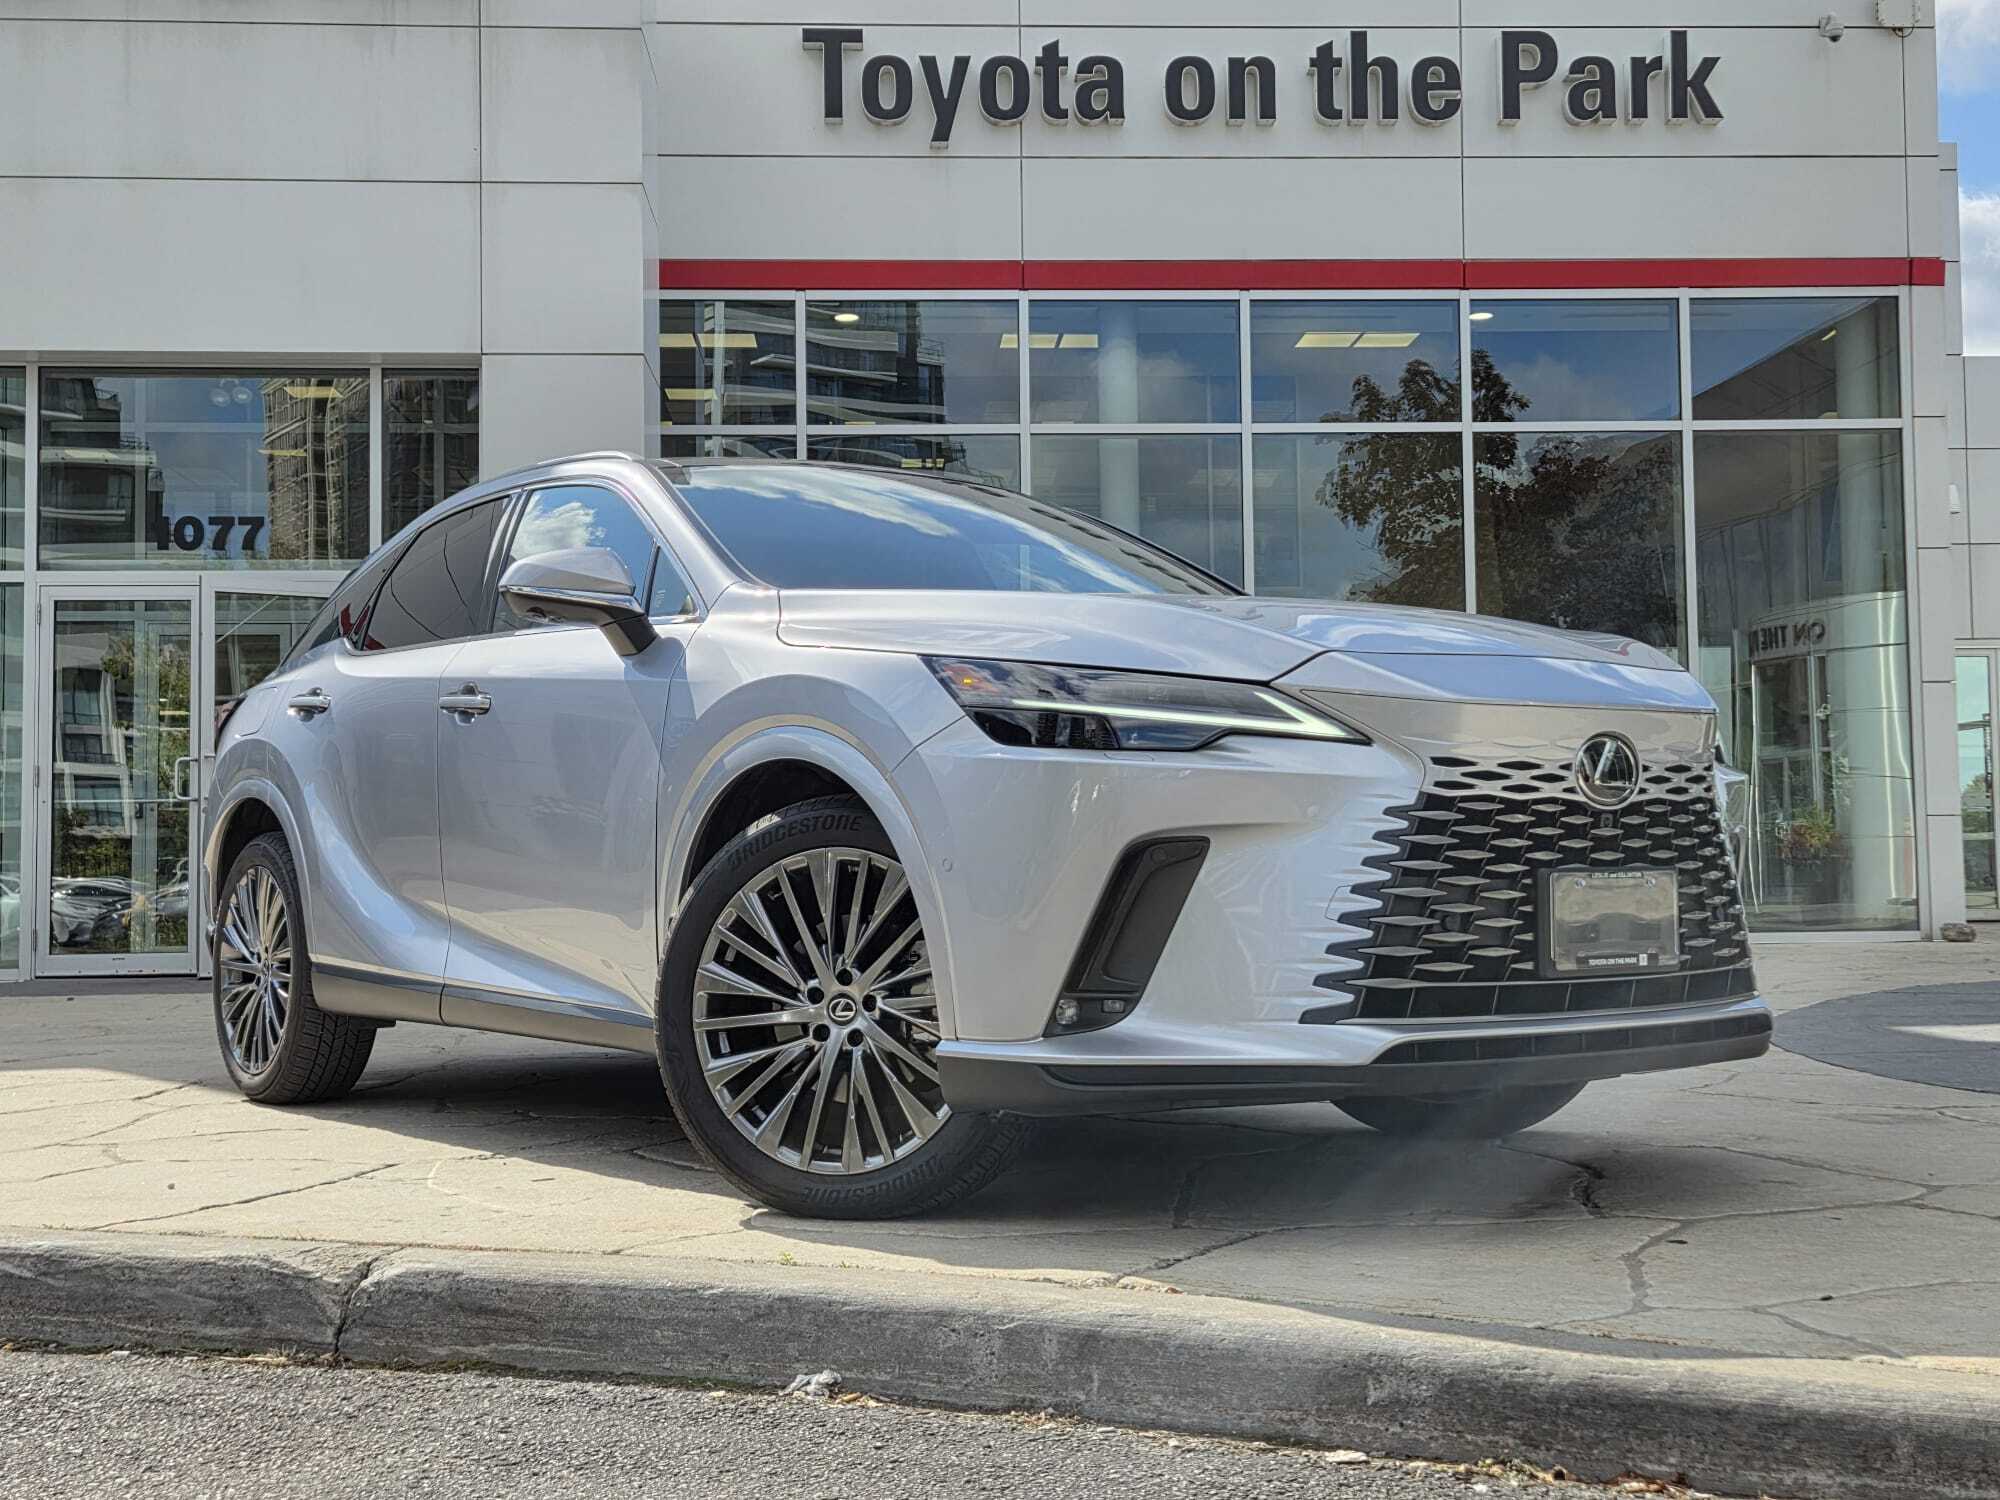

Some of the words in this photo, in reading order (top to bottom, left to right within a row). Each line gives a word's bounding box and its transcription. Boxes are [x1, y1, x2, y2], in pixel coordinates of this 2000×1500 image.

[802, 28, 1125, 148] Toyota
[1163, 54, 1277, 126] on
[1308, 30, 1462, 127] the
[1497, 29, 1723, 127] Park
[155, 515, 265, 551] 1077
[727, 814, 864, 868] BRIDGESTONE
